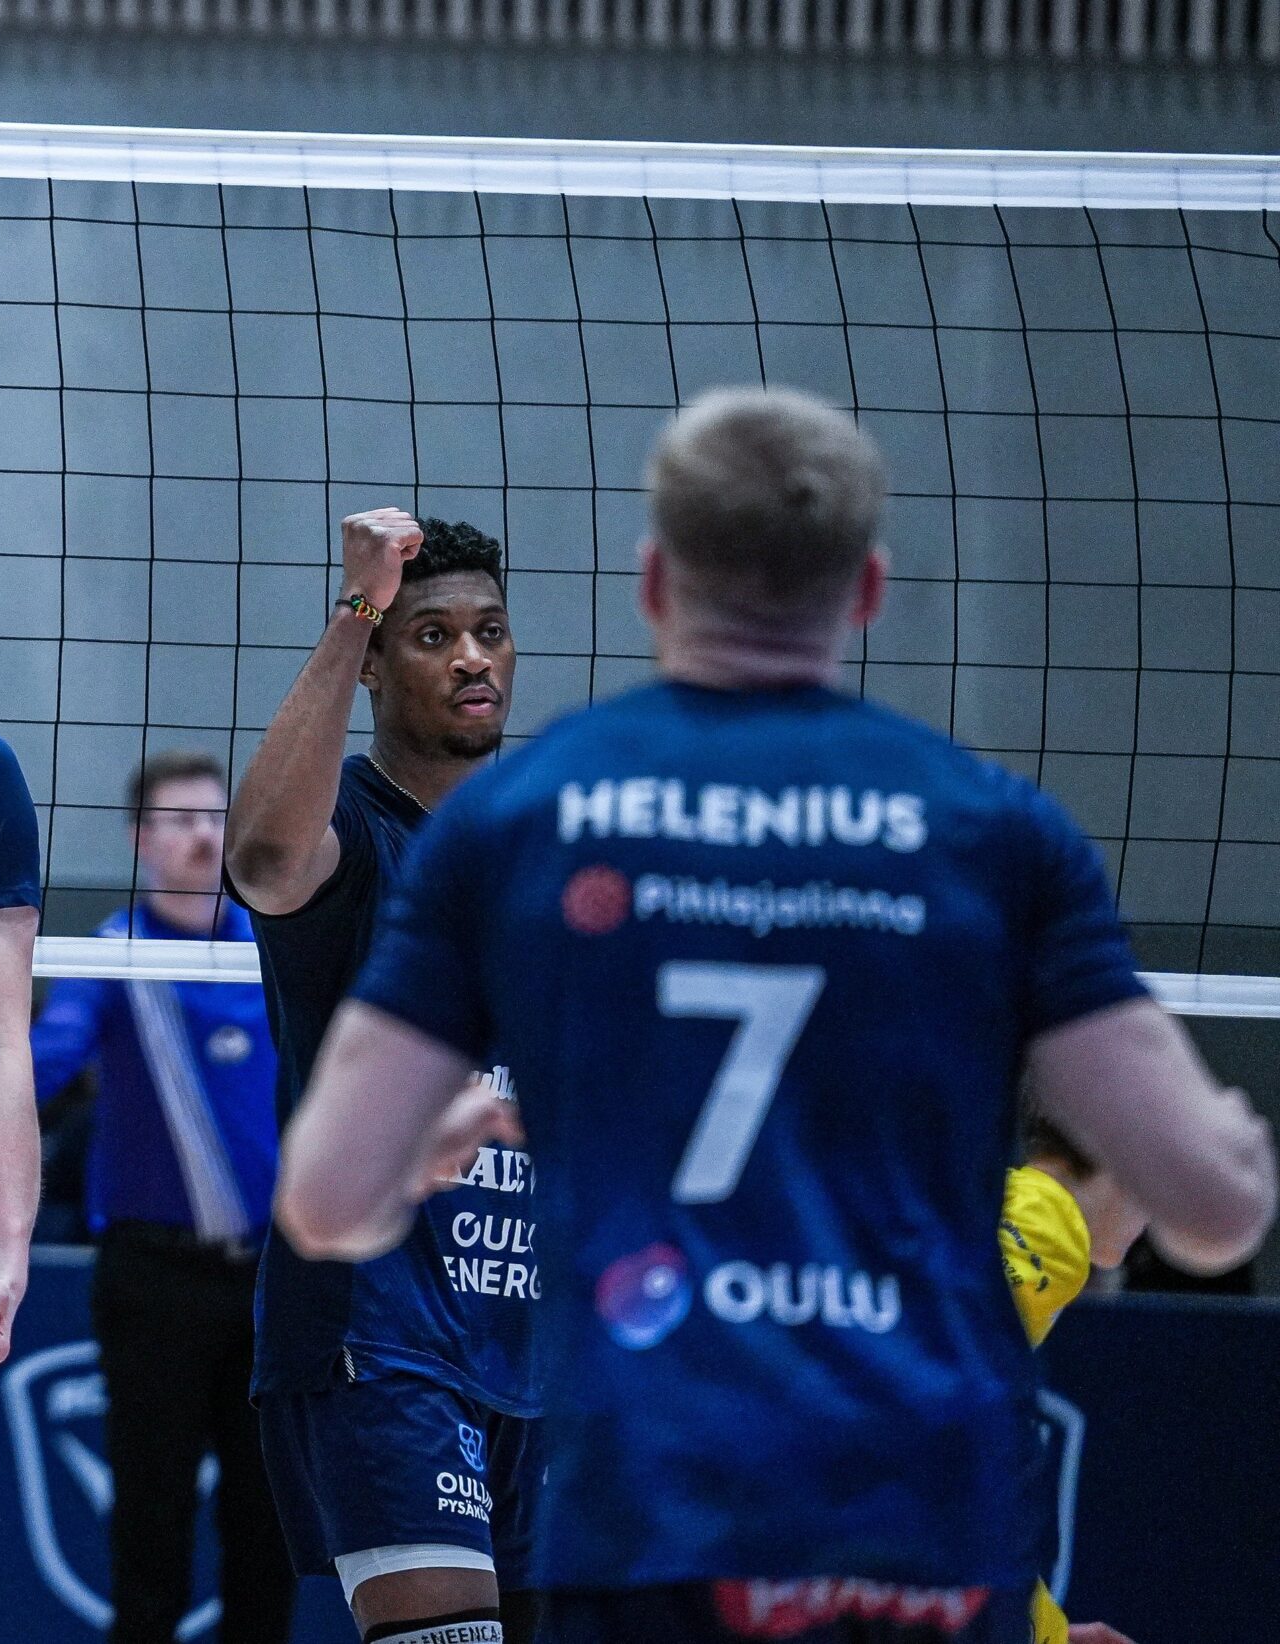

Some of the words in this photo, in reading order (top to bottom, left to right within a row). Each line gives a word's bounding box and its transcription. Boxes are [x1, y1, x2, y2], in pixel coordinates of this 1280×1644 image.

[557, 777, 929, 853] HELENIUS
[655, 959, 827, 1204] 7
[703, 1259, 902, 1334] OULU
[438, 1497, 490, 1524] PYSÄKÖ
